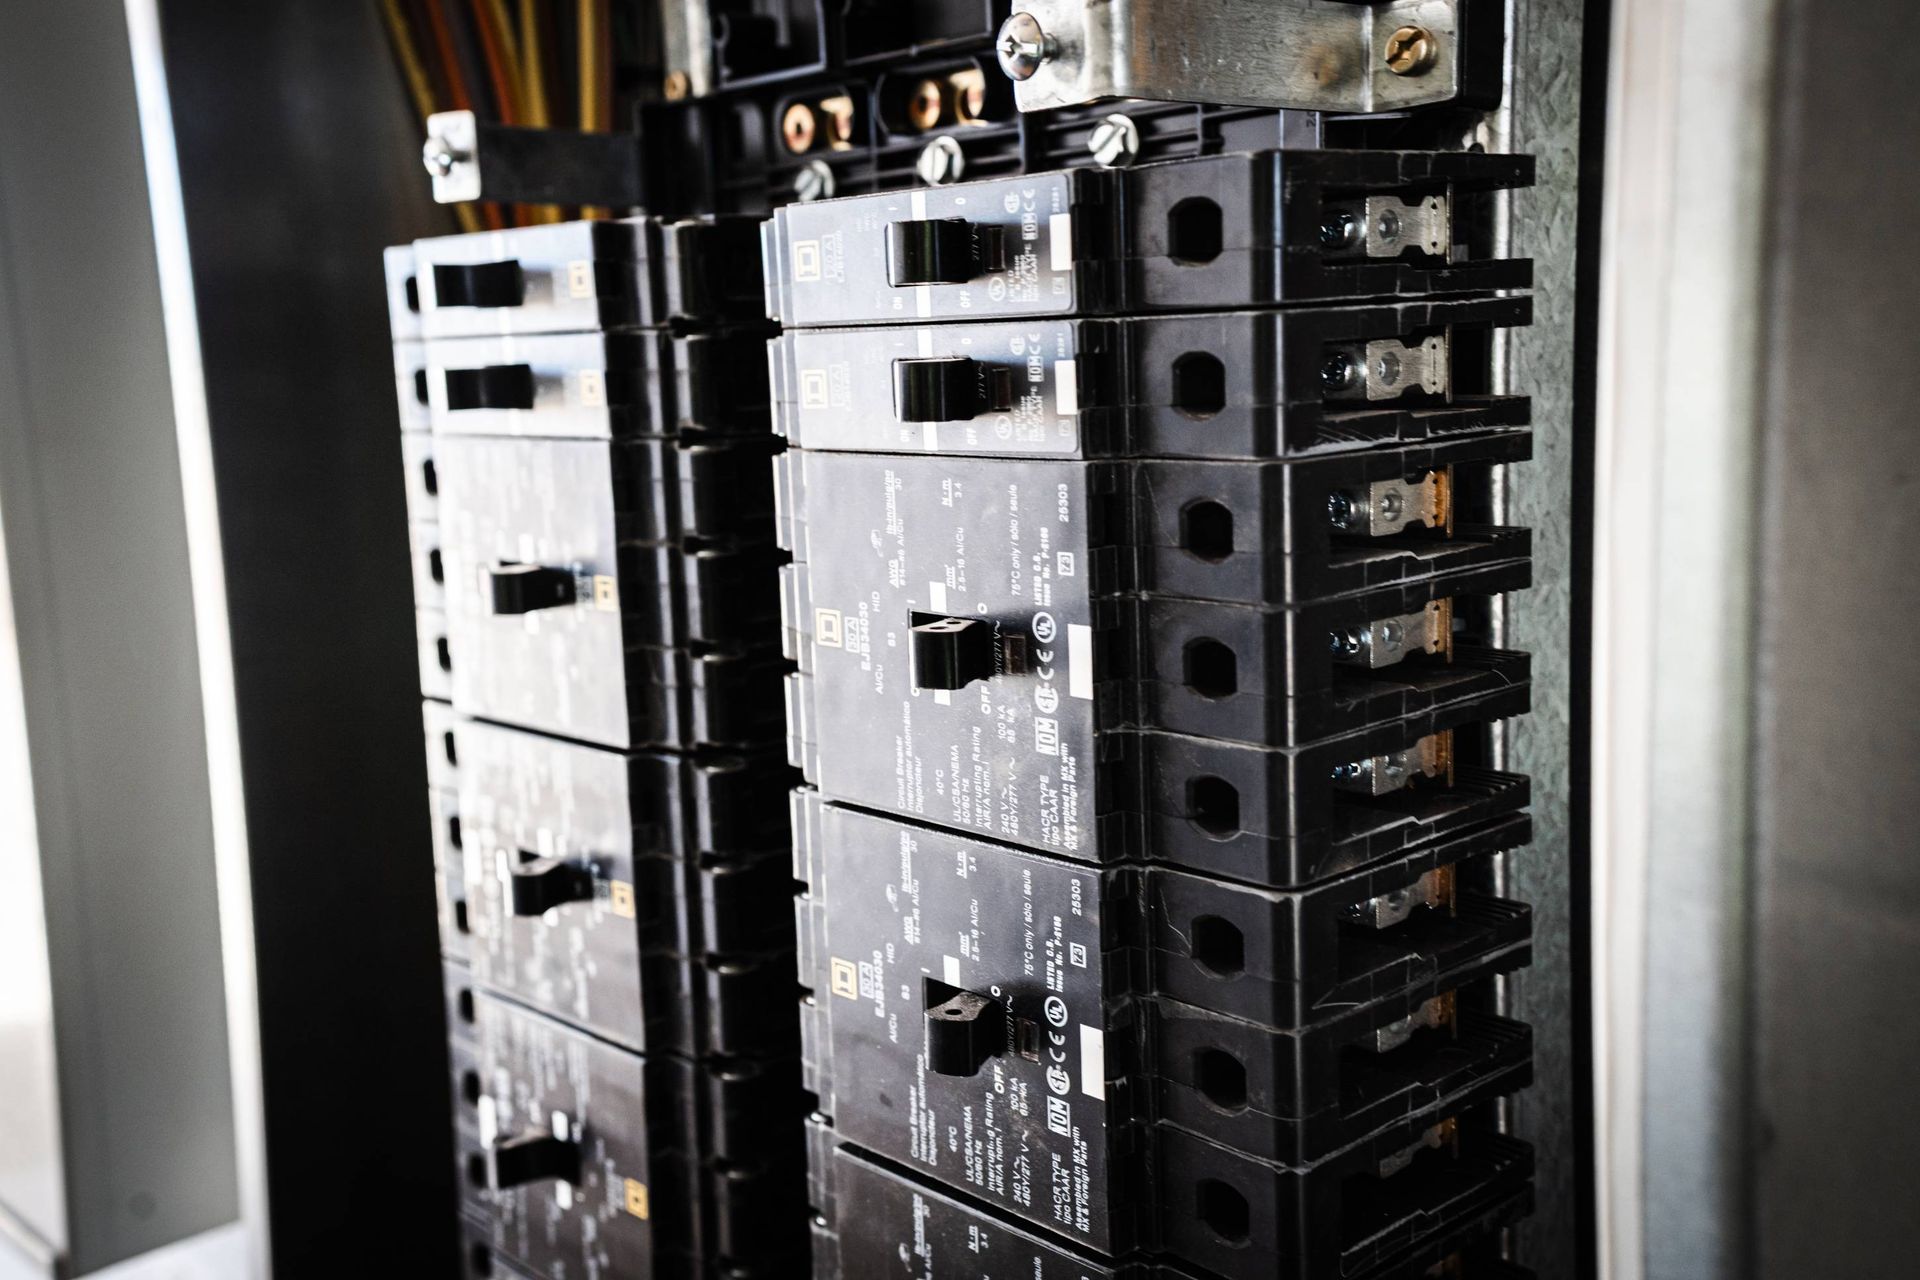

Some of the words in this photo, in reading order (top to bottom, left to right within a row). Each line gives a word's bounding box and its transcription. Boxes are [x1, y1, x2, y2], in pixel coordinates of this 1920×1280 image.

[892, 296, 903, 309] ON
[960, 290, 971, 308] OFF
[900, 429, 910, 442] ON
[966, 428, 977, 445] OFF
[895, 478, 902, 491] 30
[954, 483, 962, 498] 3.4
[1008, 484, 1018, 512] seule
[1058, 484, 1069, 522] 25303
[1010, 548, 1022, 569] only
[872, 591, 880, 612] HID
[1034, 576, 1043, 606] LISTED
[858, 601, 871, 671] EJB34030
[875, 664, 883, 694] Al/Cu
[1036, 649, 1054, 680] CE
[981, 686, 991, 714] OFF
[997, 705, 1005, 720] kA
[1006, 708, 1015, 723] kA
[972, 726, 982, 761] Rating
[998, 723, 1006, 739] 100
[1036, 717, 1058, 755] NOM
[896, 735, 904, 775] Breaker
[905, 759, 914, 812] Interruptor
[914, 756, 924, 813] Disjoncteur
[951, 745, 962, 822] UL/CSA/NEMA
[962, 778, 970, 793] Hz
[983, 767, 991, 795] nom.
[1061, 766, 1068, 781] MX
[896, 778, 905, 809] Circuit
[973, 765, 983, 827] Interrupting
[1040, 775, 1049, 805] TYPE
[962, 794, 971, 824] 50/60
[982, 798, 991, 830] AIR/A
[1009, 784, 1019, 836] 480Y/277
[1050, 789, 1059, 823] CAAR
[1001, 814, 1010, 834] 240
[1041, 809, 1050, 843] HACR
[1052, 826, 1060, 846] tipo
[910, 840, 918, 852] 30
[969, 856, 977, 872] 3.4
[1022, 870, 1031, 895] seule
[1072, 879, 1082, 916] 25303
[970, 899, 978, 927] Al/Cu
[886, 943, 895, 964] HID
[1024, 929, 1035, 950] only
[873, 950, 885, 1018] EJB34030
[1047, 961, 1055, 990] LISTED
[890, 1014, 898, 1043] Al/Cu
[1049, 1031, 1066, 1062] CE
[994, 1064, 1004, 1094] OFF
[1010, 1078, 1018, 1092] kA
[1019, 1082, 1027, 1097] kA
[909, 1085, 918, 1125] Breaker
[985, 1092, 995, 1127] Rating
[1010, 1094, 1019, 1110] 100
[1048, 1096, 1070, 1136] NOM
[911, 1127, 919, 1158] Circuit
[919, 1111, 928, 1162] Interruptor
[927, 1110, 938, 1166] Disjoncteur
[964, 1106, 974, 1181] UL/CSA/NEMA
[974, 1140, 982, 1155] Hz
[995, 1135, 1003, 1161] nom.
[1052, 1152, 1061, 1183] TYPE
[1073, 1149, 1080, 1163] MX
[1074, 1165, 1081, 1174] in
[974, 1157, 984, 1186] 50/60
[996, 1164, 1004, 1196] AIR/A
[1021, 1156, 1030, 1206] 480Y/277
[1062, 1169, 1070, 1202] CAAR
[1013, 1183, 1022, 1203] 240
[1081, 1168, 1089, 1206] Foreign
[1054, 1186, 1063, 1221] HACR
[1064, 1204, 1072, 1224] tipo
[1074, 1176, 1082, 1230] Assembled
[1081, 1217, 1089, 1233] MX
[981, 1233, 989, 1248] 3.4
